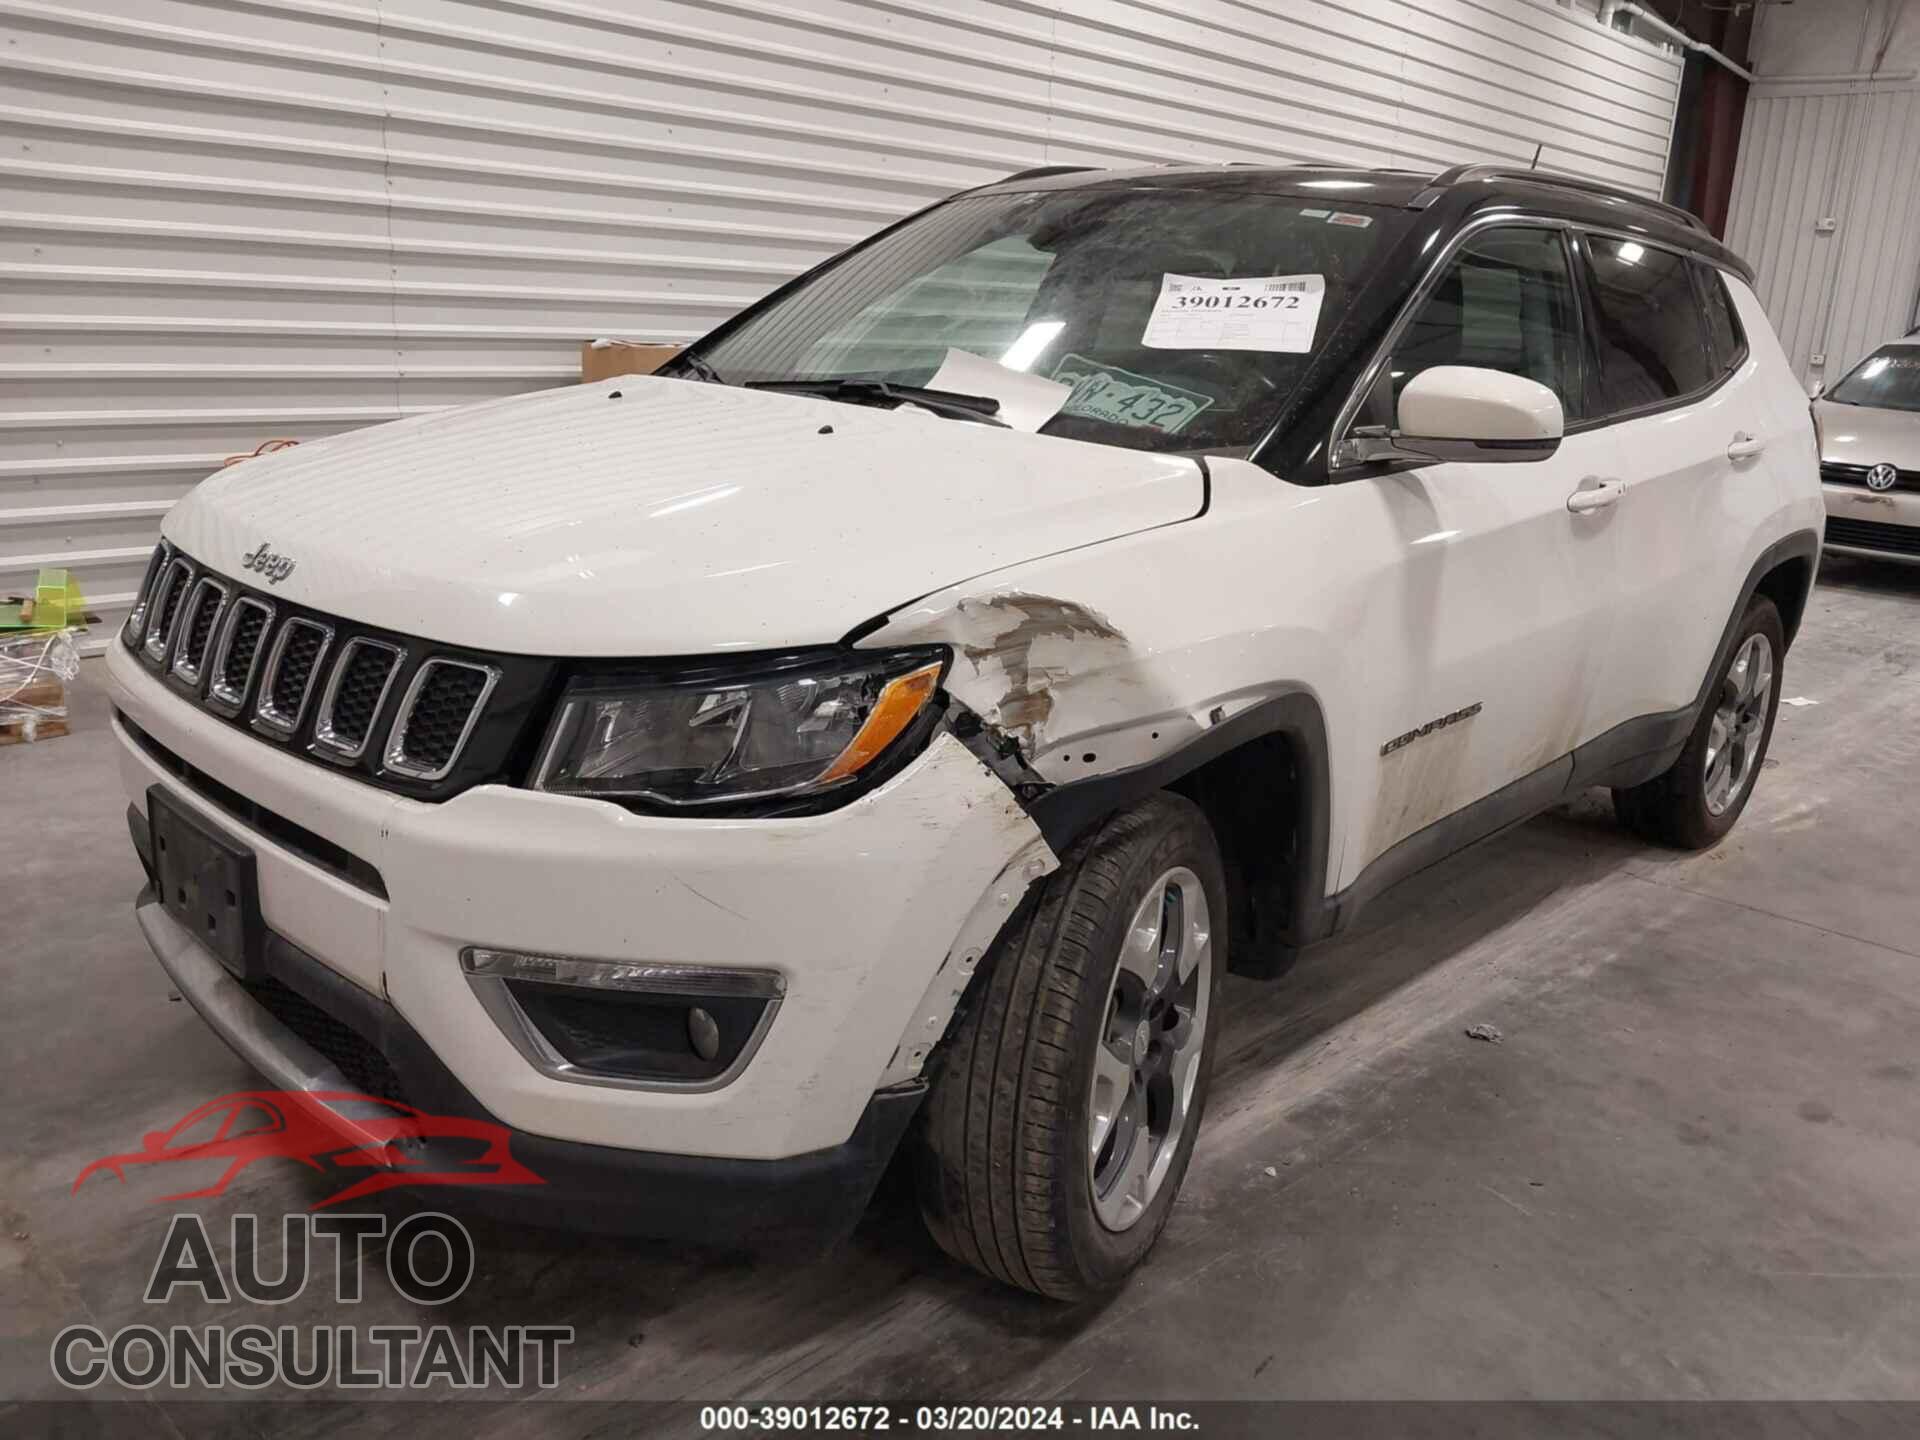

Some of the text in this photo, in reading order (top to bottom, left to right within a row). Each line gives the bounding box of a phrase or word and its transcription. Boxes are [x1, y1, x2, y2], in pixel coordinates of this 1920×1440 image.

[1171, 295, 1300, 310] 39012672
[242, 542, 297, 585] Jeep
[1380, 701, 1484, 756] COMPASS
